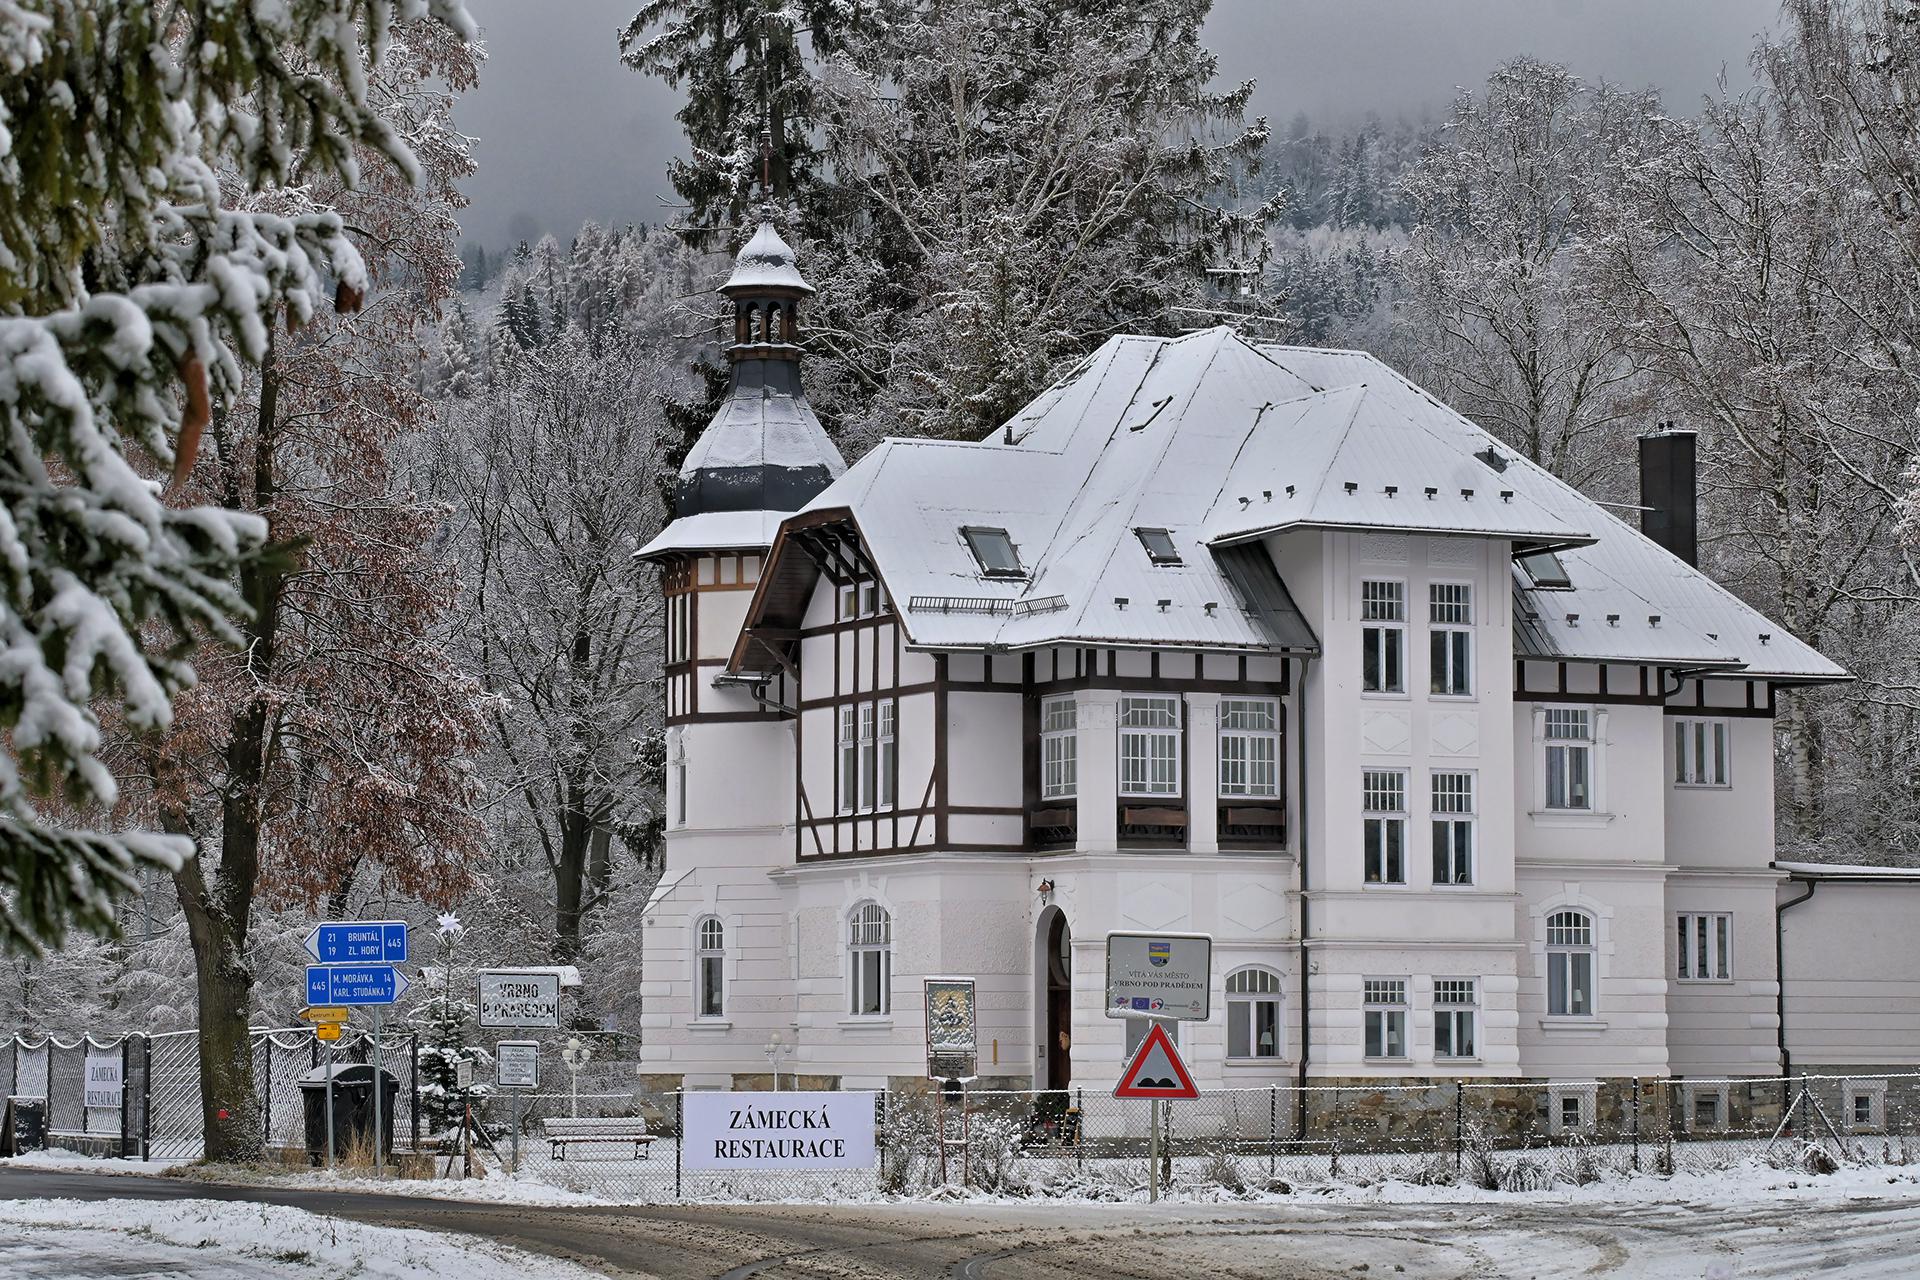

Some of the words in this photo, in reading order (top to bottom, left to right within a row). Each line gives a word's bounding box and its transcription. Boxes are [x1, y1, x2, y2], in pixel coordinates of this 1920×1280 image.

[328, 933, 336, 943] 21
[348, 931, 380, 942] BRUNTÁL
[387, 939, 402, 948] 445
[328, 947, 337, 956] 19
[348, 947, 359, 956] ZL.
[361, 946, 380, 955] HORY
[333, 974, 341, 984] M.
[342, 972, 374, 984] MORÁVKA
[383, 973, 391, 983] 14
[1165, 971, 1190, 980] MĚSTO
[312, 981, 326, 991] 445
[500, 983, 539, 998] VRBNO
[1161, 980, 1203, 990] PRADĚDEM
[333, 987, 352, 997] KARL.
[353, 986, 385, 997] STUDÁNKA
[387, 987, 392, 996] 7
[729, 1104, 831, 1129] ZÁMECKÁ
[714, 1139, 846, 1159] RESTAURACE
